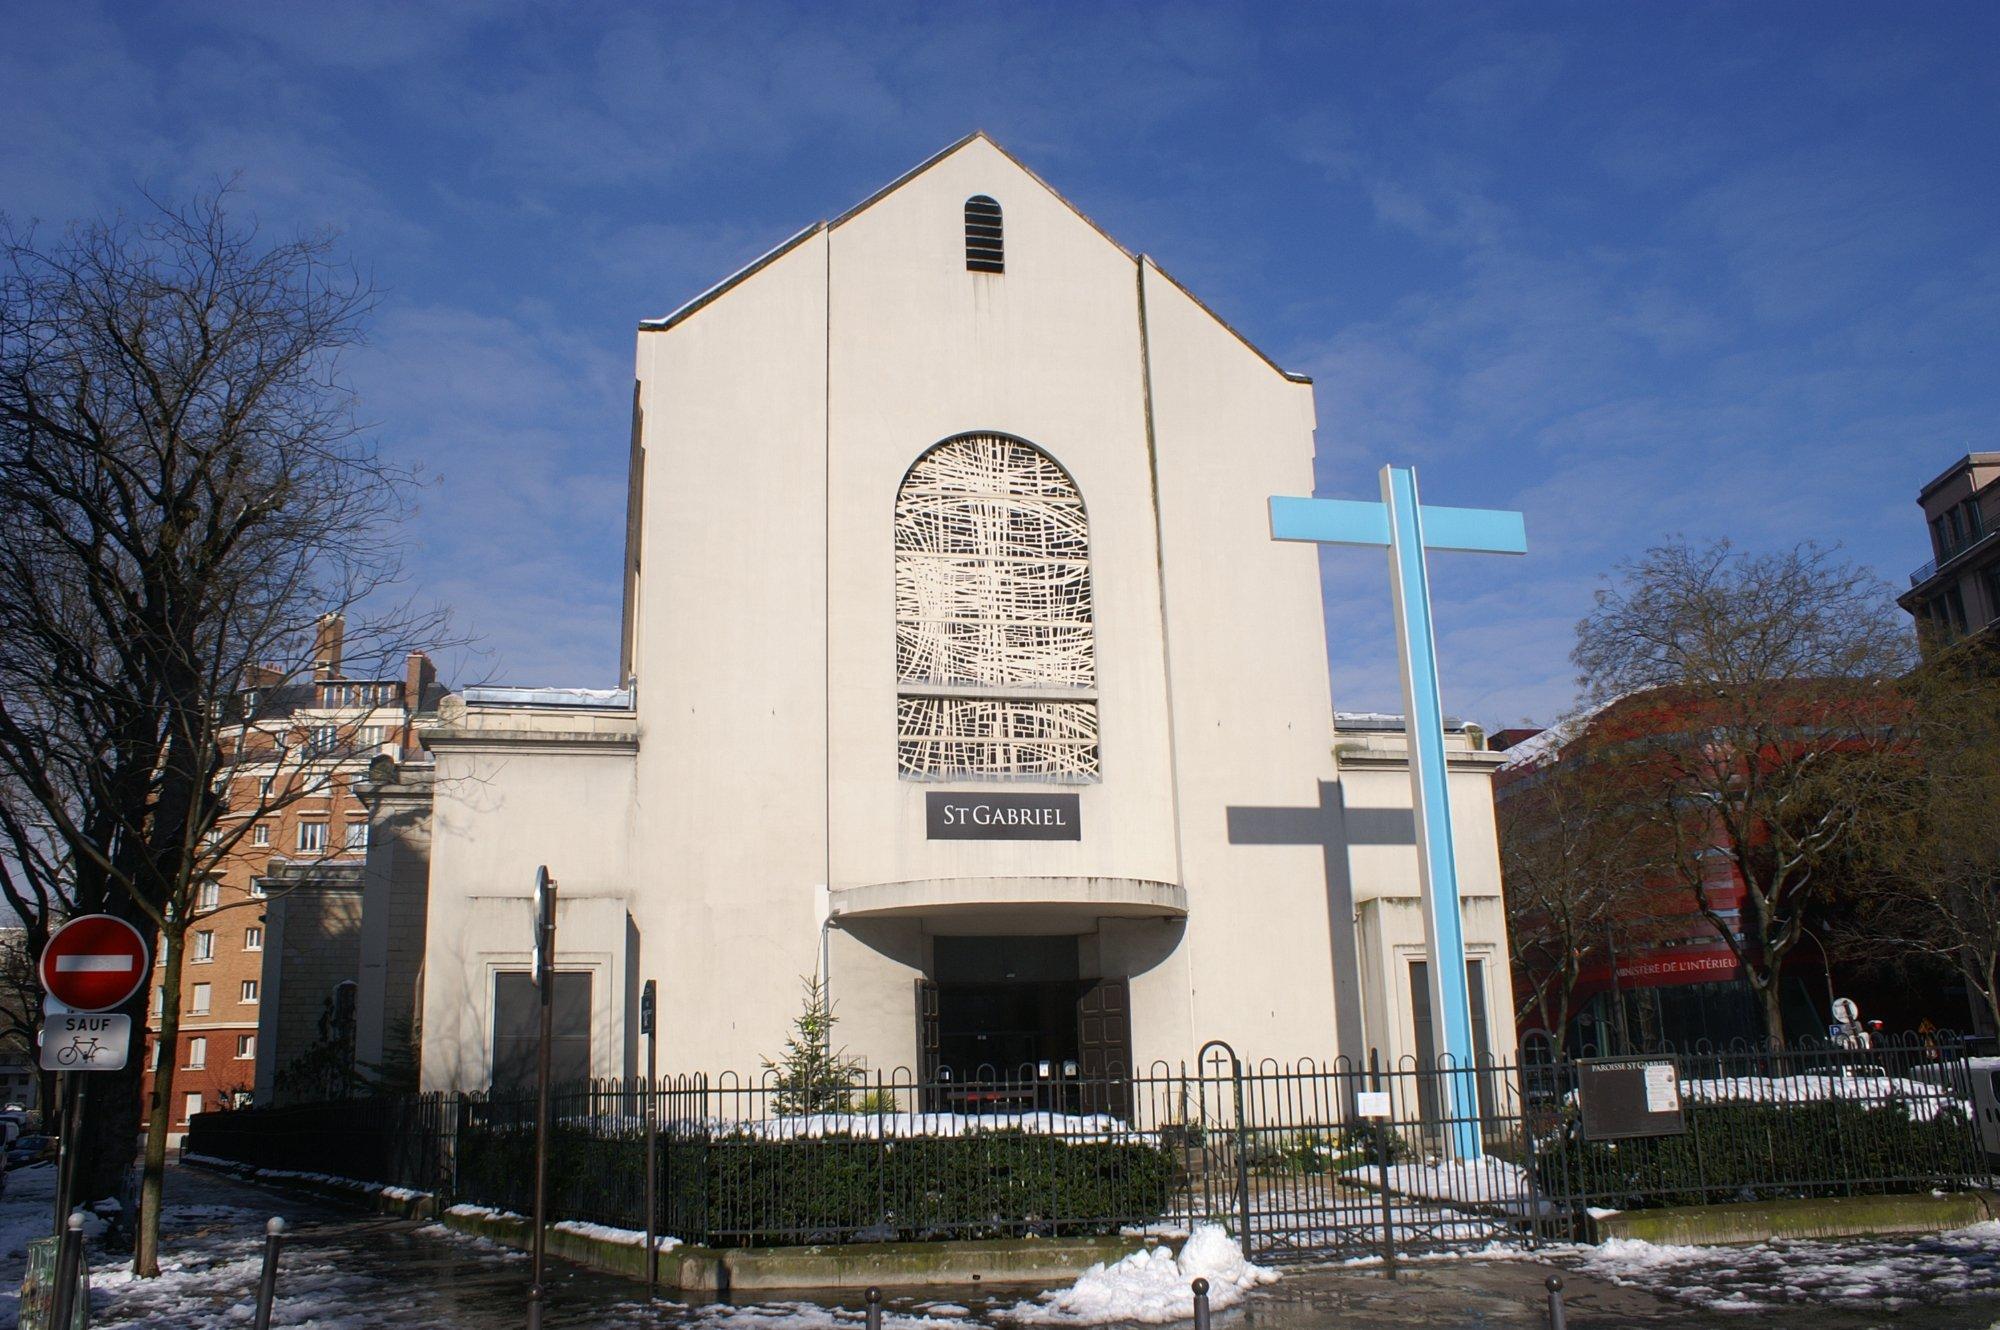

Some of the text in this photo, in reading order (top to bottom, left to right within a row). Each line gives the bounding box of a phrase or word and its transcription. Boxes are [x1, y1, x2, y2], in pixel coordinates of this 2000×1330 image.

[973, 804, 1067, 826] GABRIEL
[1662, 961, 1677, 973] DE
[1679, 957, 1738, 972] L'INTÉRIEU
[65, 1018, 112, 1032] SAUF
[1591, 1062, 1626, 1072] PAROISSE
